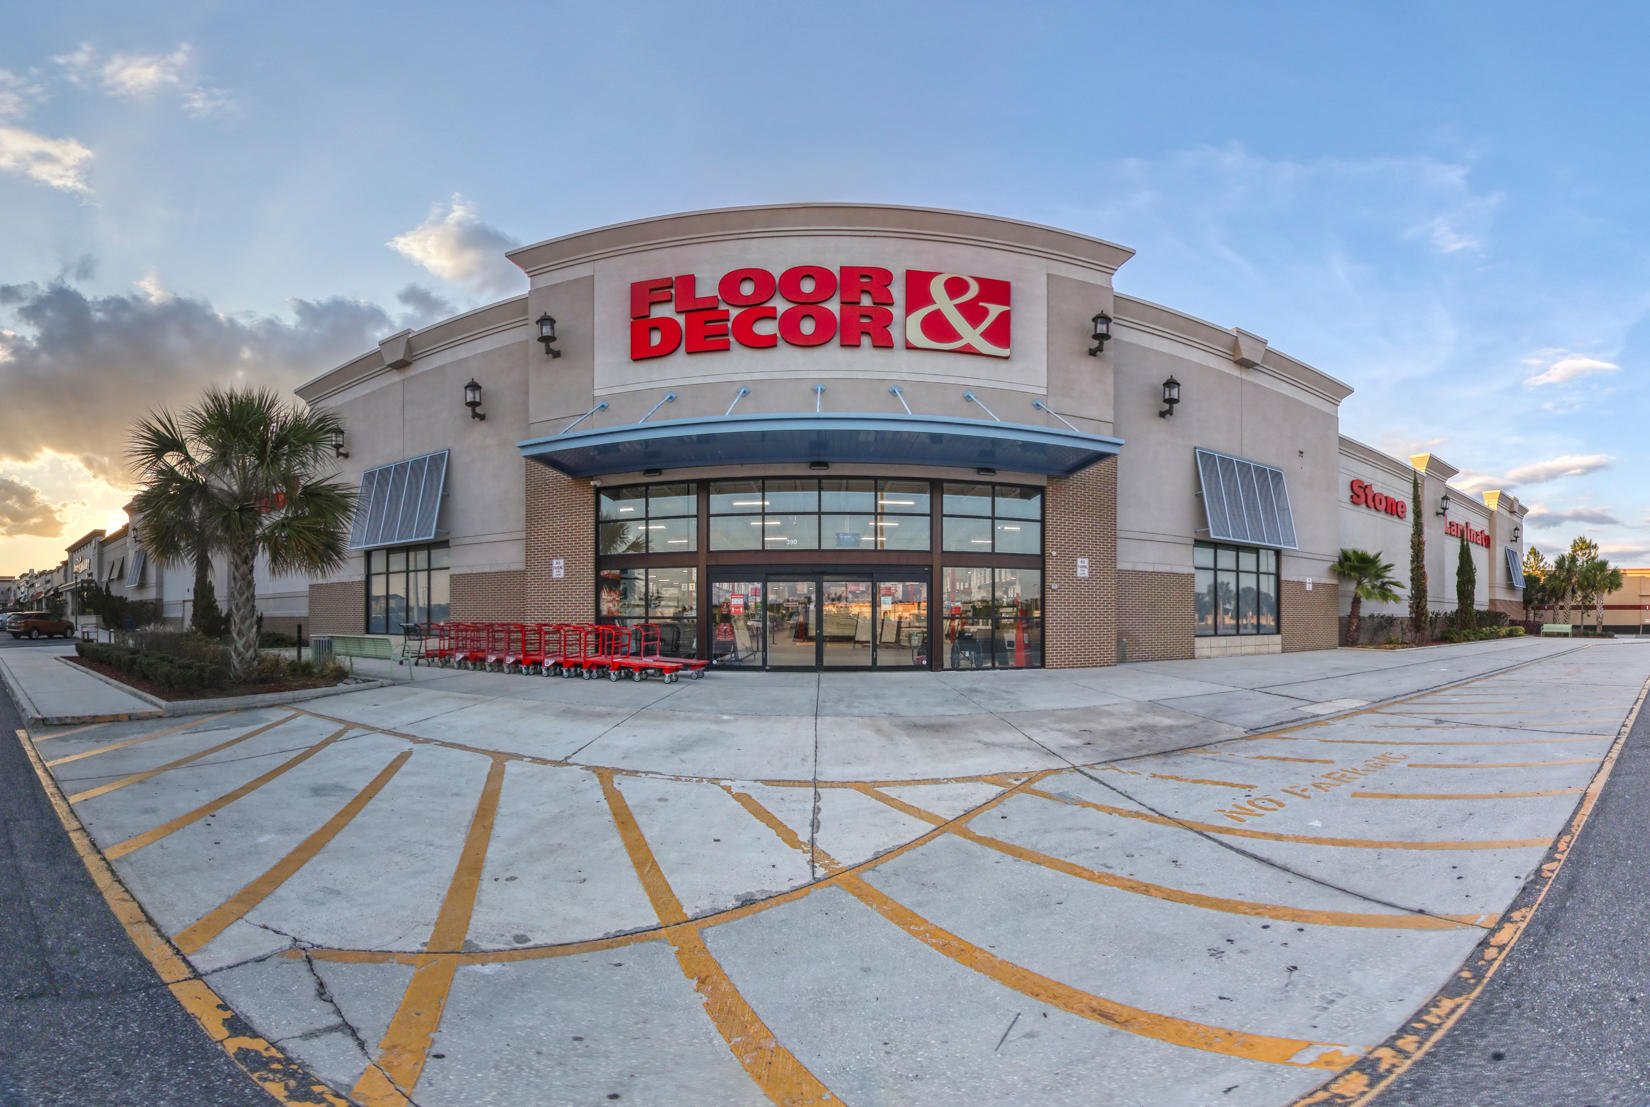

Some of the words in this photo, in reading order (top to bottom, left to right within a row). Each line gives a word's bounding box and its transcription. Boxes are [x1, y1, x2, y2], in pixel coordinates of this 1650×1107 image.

[630, 265, 894, 319] FLOOR
[905, 272, 1011, 357] &
[630, 304, 894, 360] DECOR
[1350, 479, 1407, 519] Stone
[1444, 511, 1491, 549] Laminate
[1213, 797, 1286, 823] NO
[1280, 751, 1409, 799] PARKING
